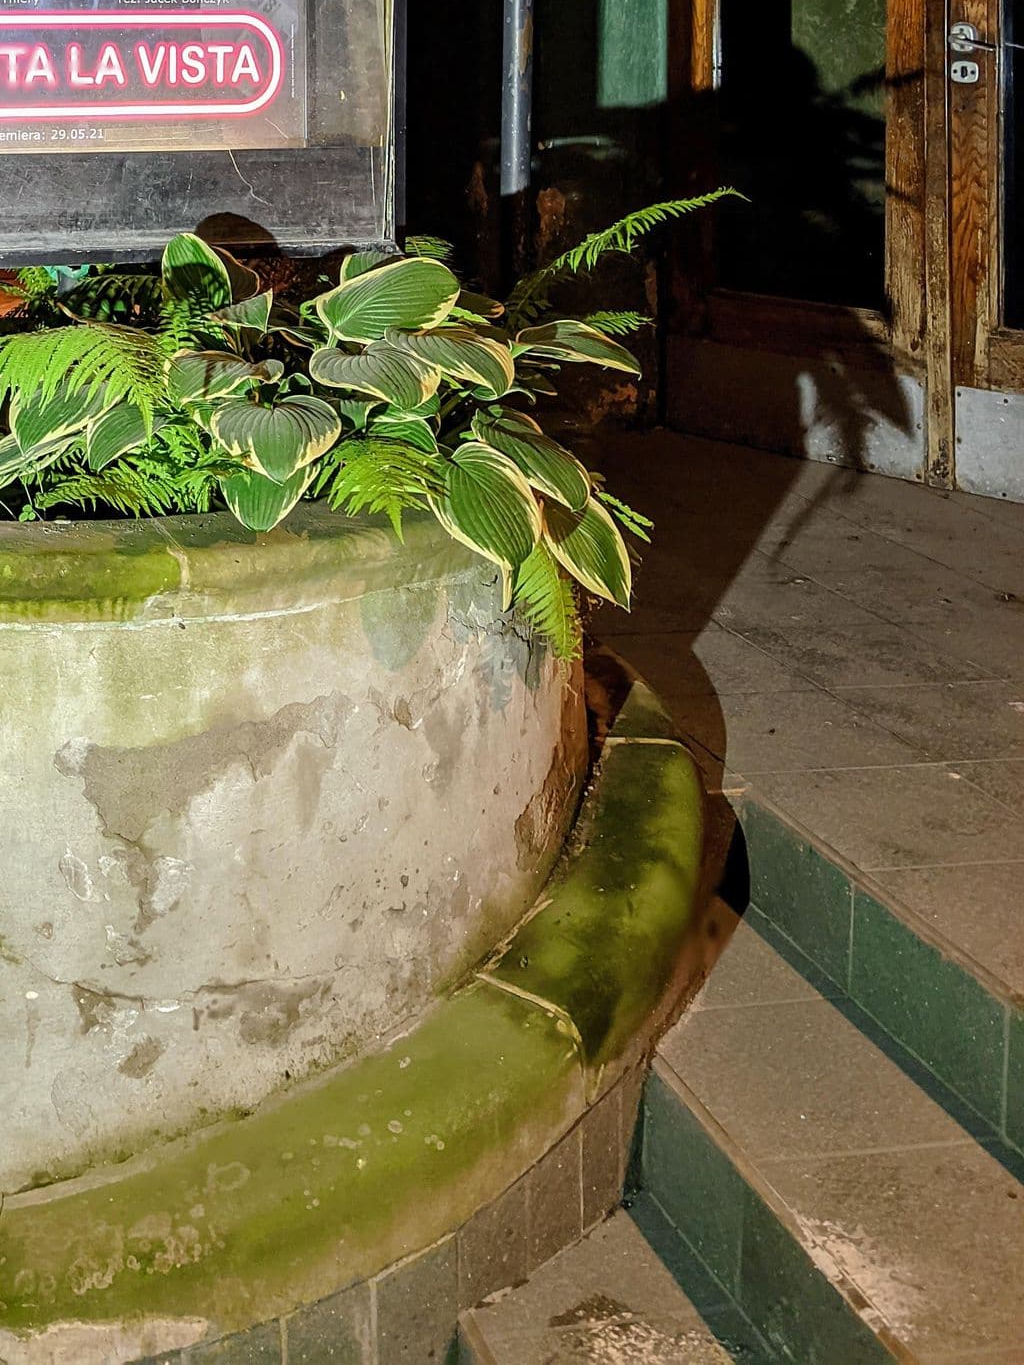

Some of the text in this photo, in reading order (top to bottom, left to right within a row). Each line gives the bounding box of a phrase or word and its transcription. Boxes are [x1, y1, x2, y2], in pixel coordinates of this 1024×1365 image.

[70, 45, 125, 86] LA
[137, 44, 261, 86] VISTA
[51, 128, 104, 140] 29.05.21
